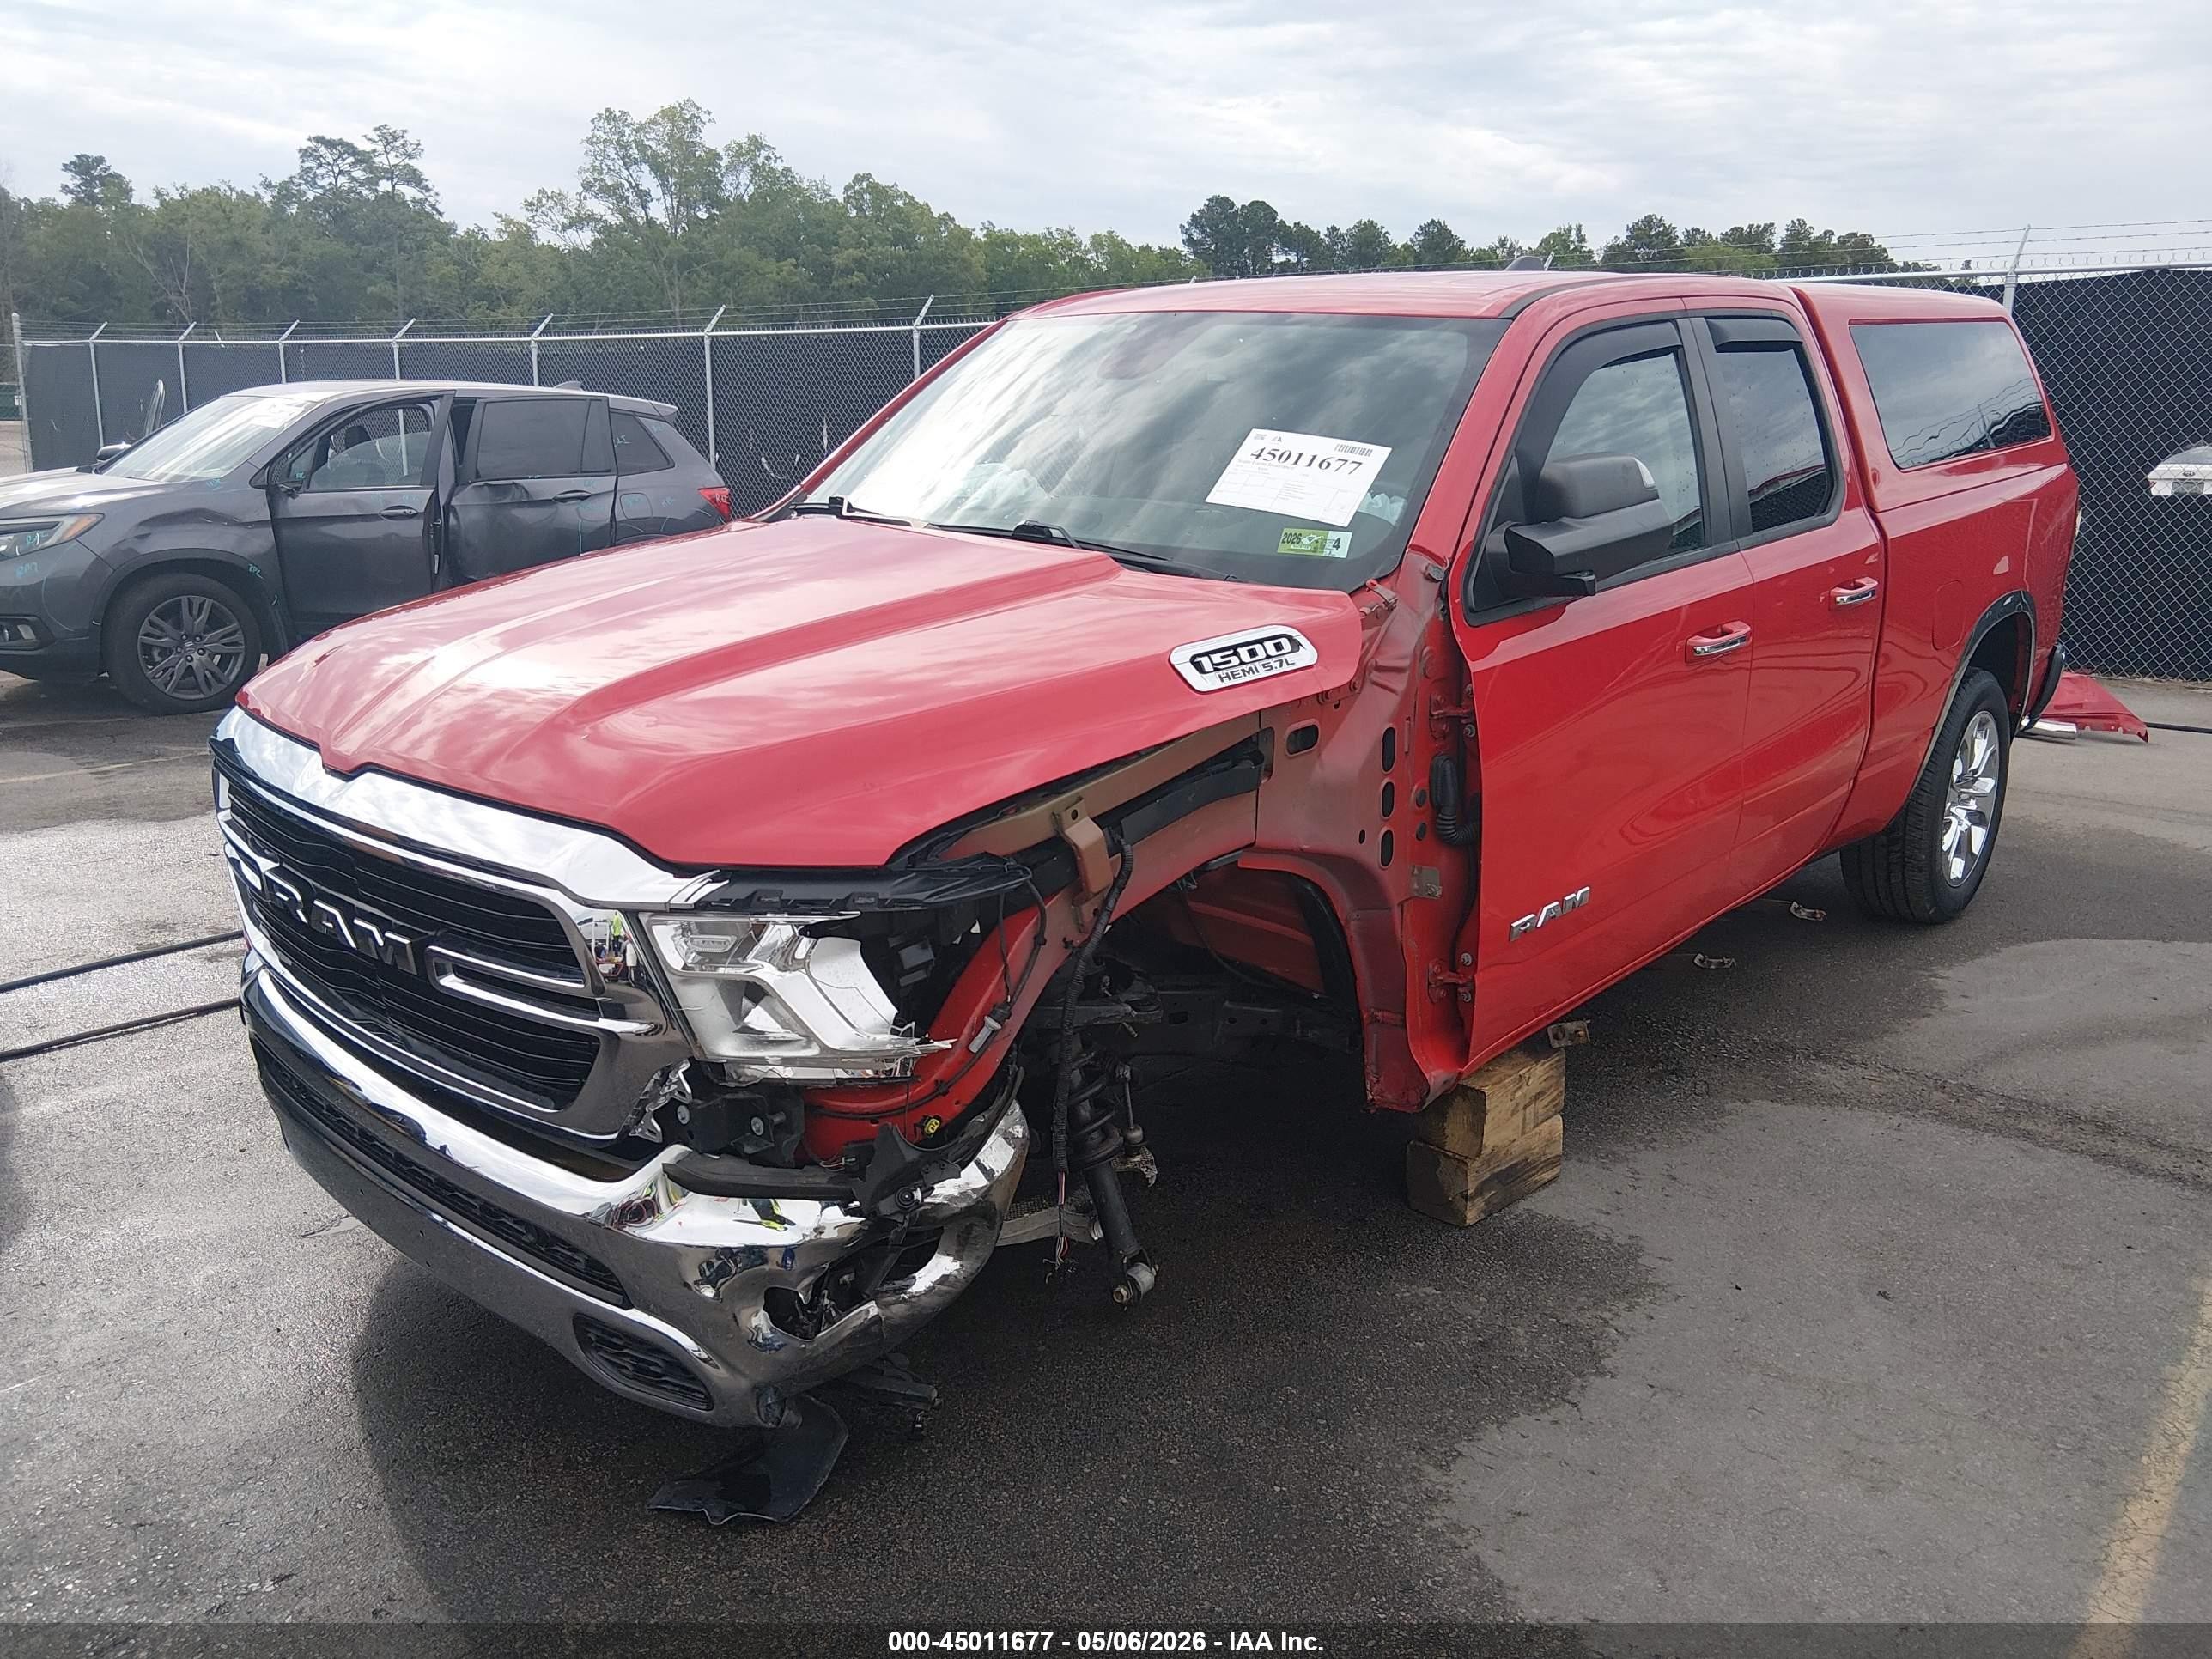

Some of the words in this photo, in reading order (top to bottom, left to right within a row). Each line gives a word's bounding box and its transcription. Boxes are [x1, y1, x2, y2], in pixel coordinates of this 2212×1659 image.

[1249, 447, 1363, 475] 45011677
[1281, 532, 1303, 544] 2026
[1332, 537, 1341, 550] 4
[1194, 638, 1292, 672] 1500
[1219, 665, 1259, 683] HEMI
[1261, 658, 1296, 672] 5.7L
[264, 869, 419, 975] RAM
[1509, 885, 1591, 942] RAM
